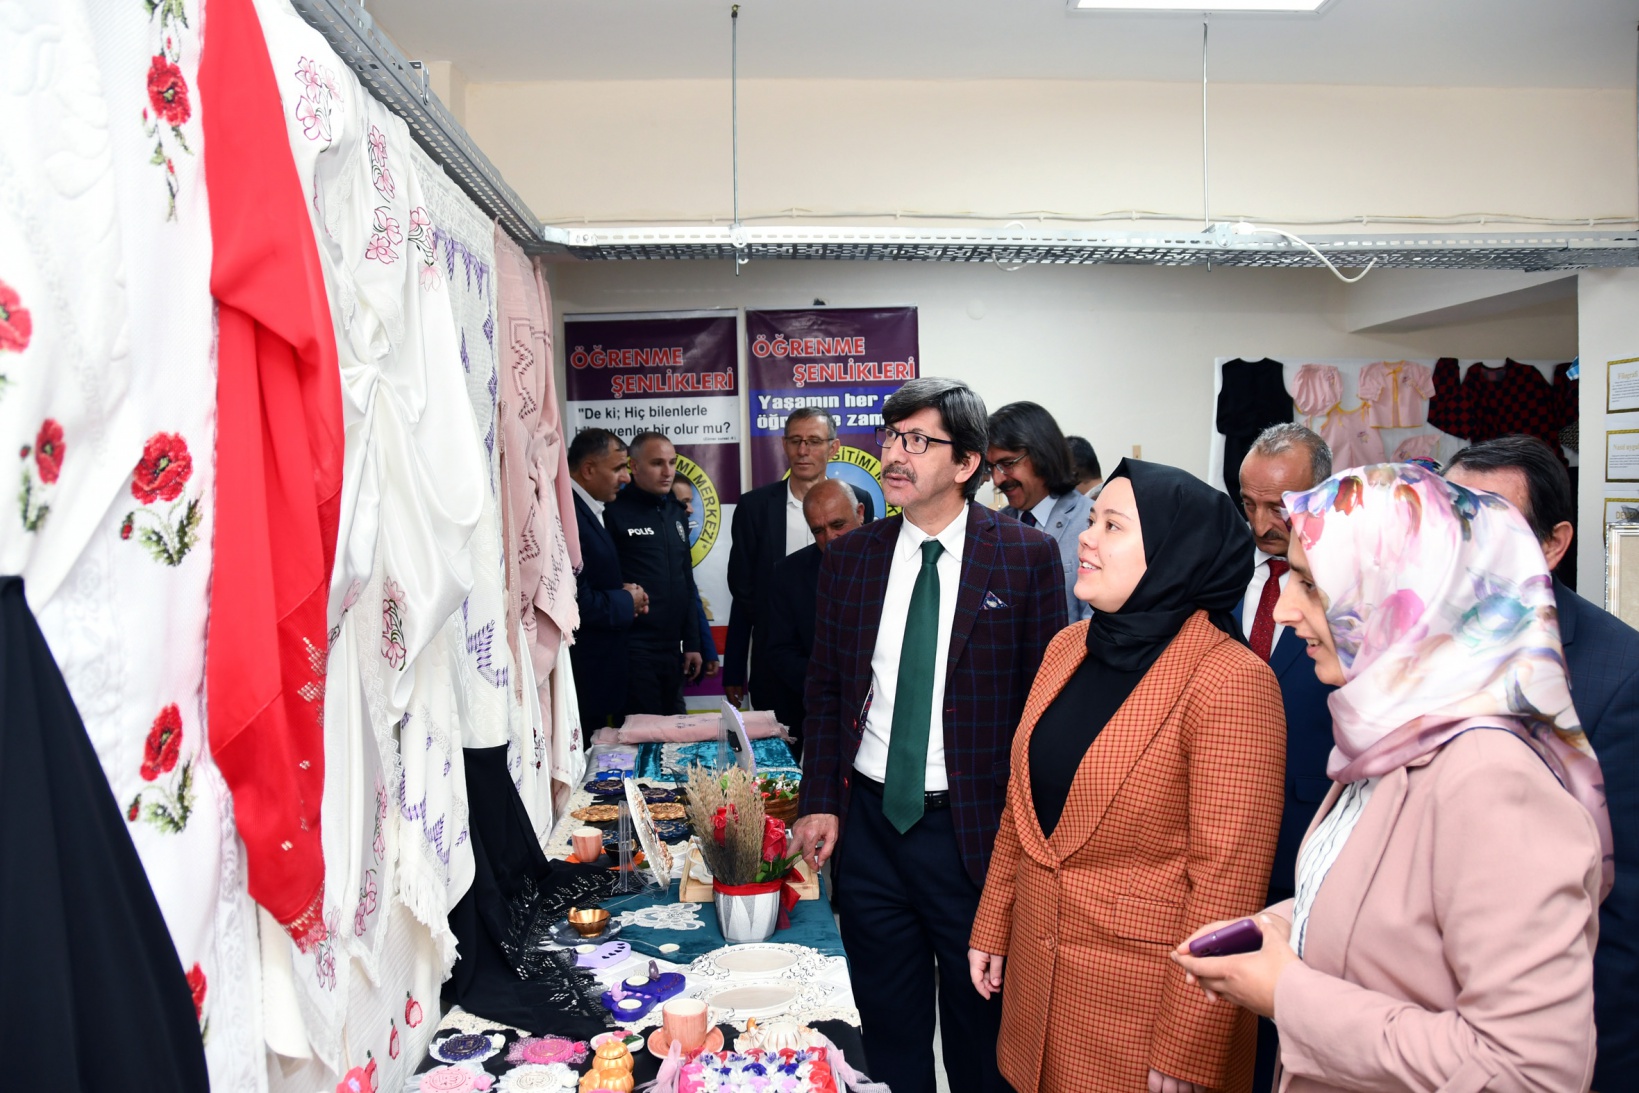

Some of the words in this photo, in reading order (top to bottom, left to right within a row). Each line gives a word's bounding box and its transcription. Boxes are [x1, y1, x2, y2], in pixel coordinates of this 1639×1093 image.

[570, 345, 684, 369] ÖĞRENME
[752, 334, 865, 358] ÖĞRENME
[611, 367, 734, 398] ŞENLİKLERİ
[793, 356, 915, 387] ŞENLİKLERİ
[578, 407, 602, 420] "De
[605, 406, 621, 421] ki;
[624, 406, 645, 421] Hiç
[649, 404, 708, 418] bilenlerle
[758, 395, 840, 411] Yaşamın
[844, 393, 879, 409] her
[653, 424, 670, 436] bir
[674, 423, 699, 435] olur
[703, 422, 731, 434] mu?
[756, 413, 842, 431] öğre
[846, 414, 886, 427] zam
[693, 473, 718, 547] MERKEZİ
